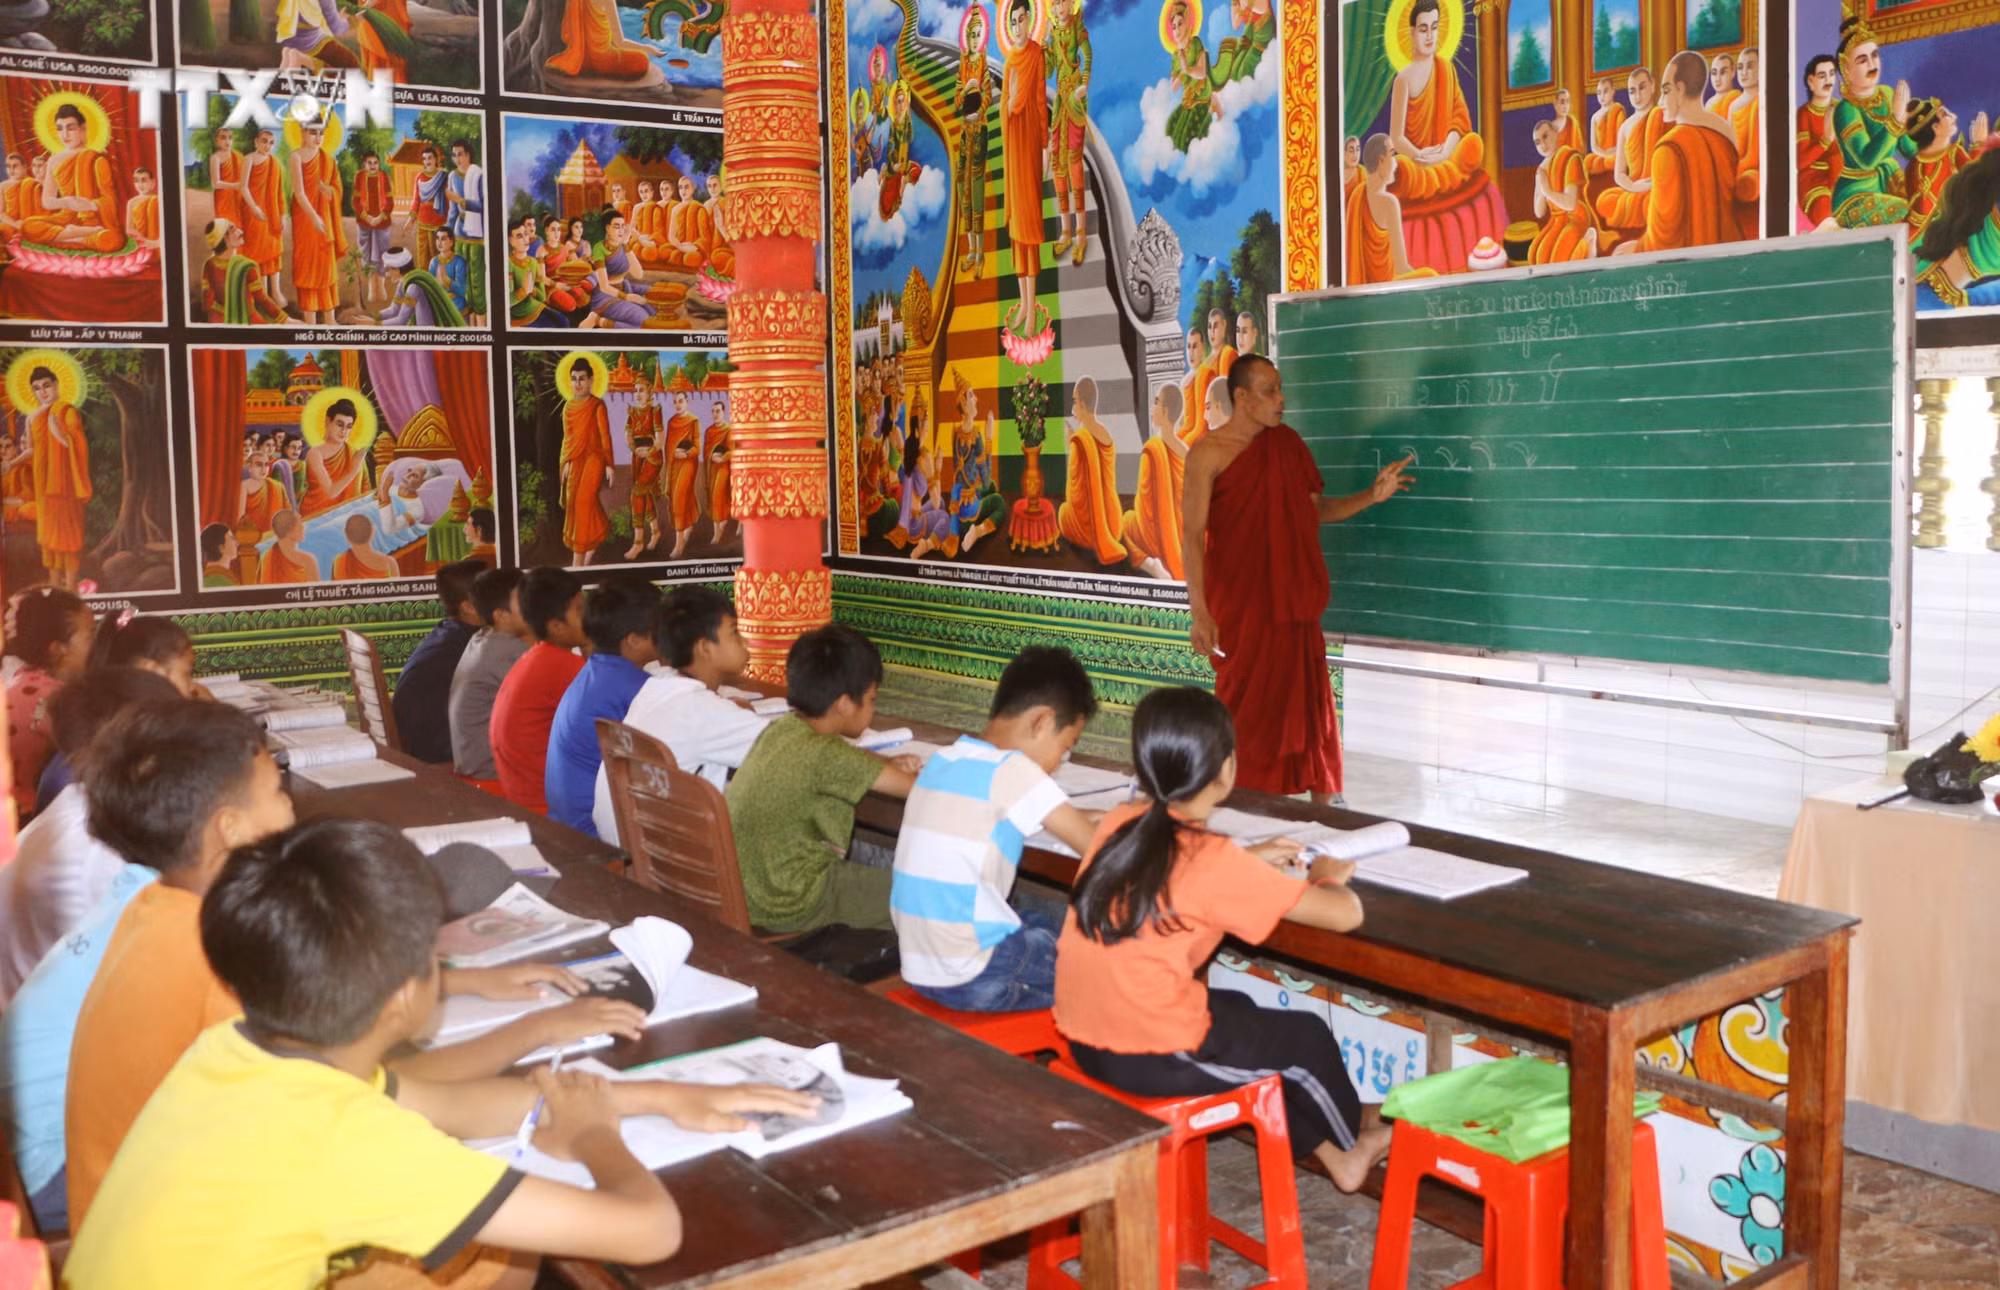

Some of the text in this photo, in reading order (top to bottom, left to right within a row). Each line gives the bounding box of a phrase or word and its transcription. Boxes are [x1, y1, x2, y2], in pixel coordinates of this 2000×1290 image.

[50, 61, 76, 72] USA
[418, 93, 439, 104] USA
[672, 112, 681, 122] LÊ
[108, 331, 143, 340] THANH
[295, 330, 314, 341] NGÔ
[368, 331, 388, 342] NGÔ
[389, 333, 407, 342] CAO
[376, 583, 410, 595] HOÀNG
